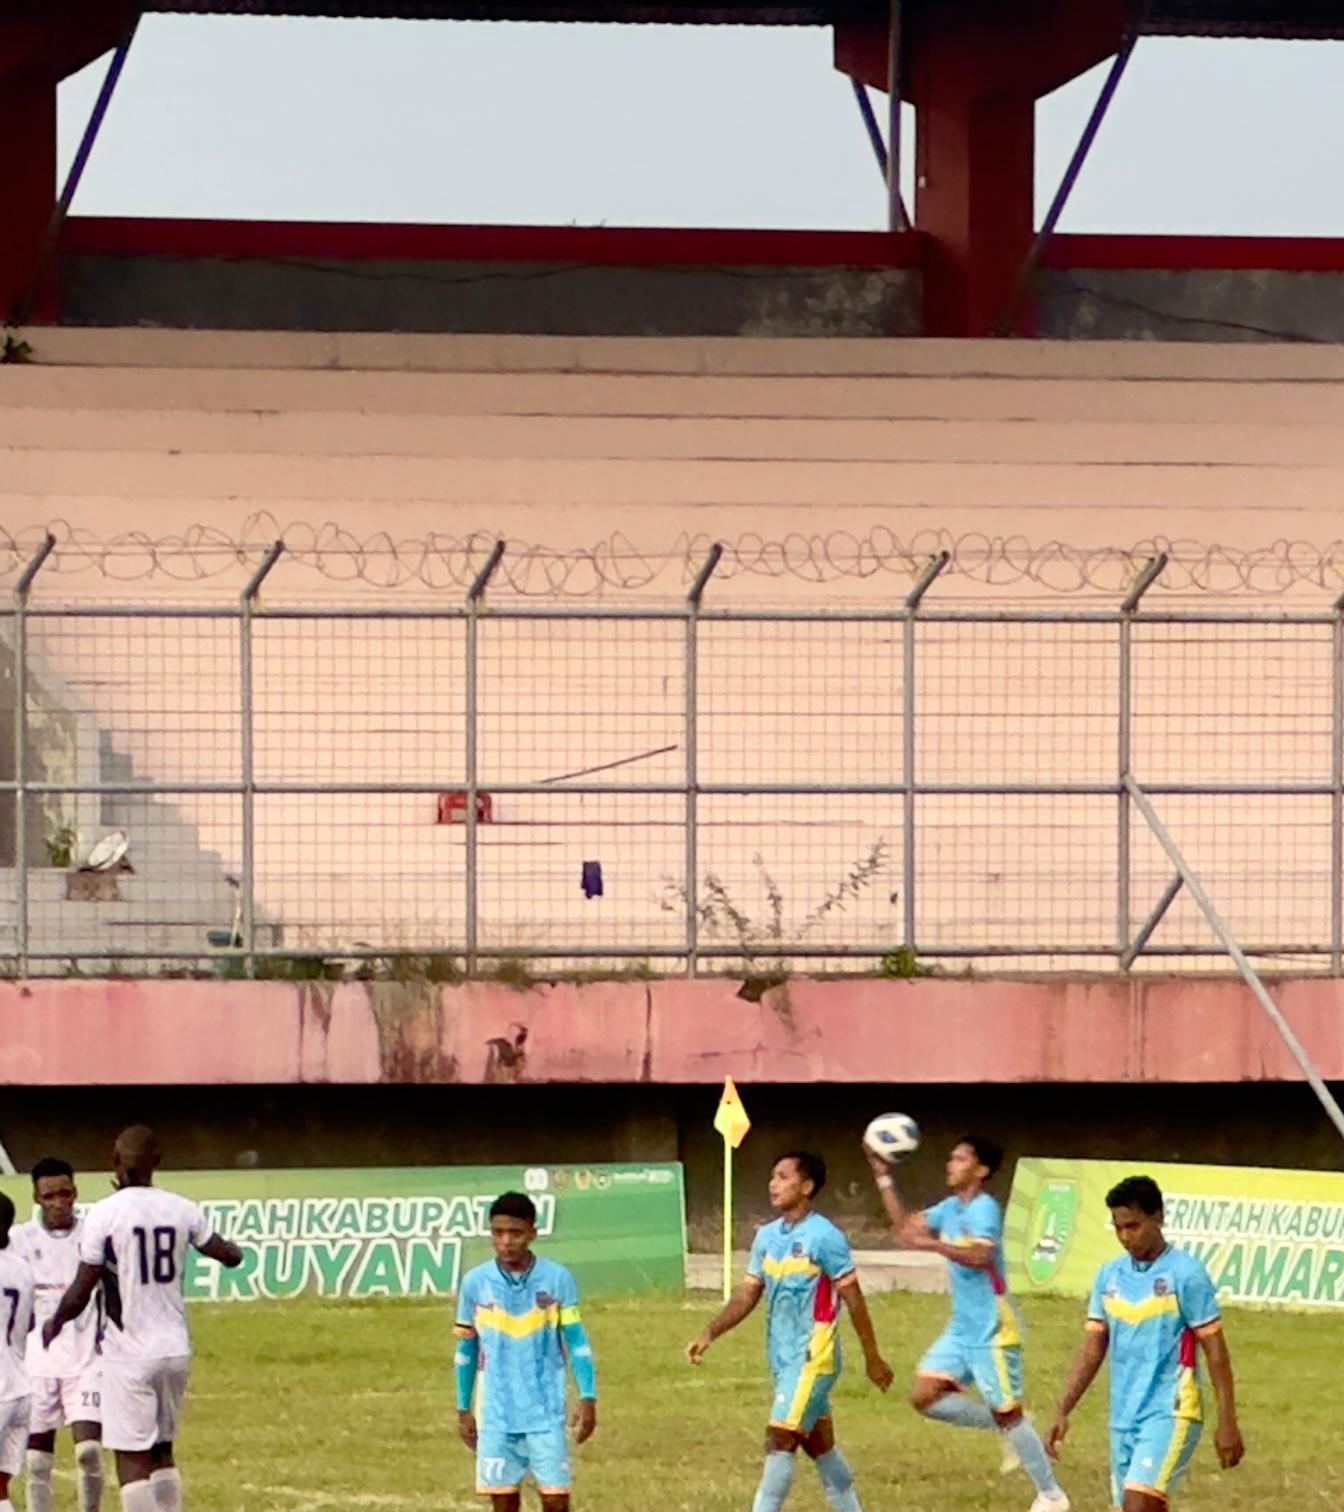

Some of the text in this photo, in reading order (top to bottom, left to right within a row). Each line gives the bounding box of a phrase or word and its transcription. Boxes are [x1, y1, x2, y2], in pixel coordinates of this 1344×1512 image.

[132, 1226, 176, 1286] 18
[182, 1240, 459, 1299] ERUYAN
[3, 1287, 21, 1346] 7
